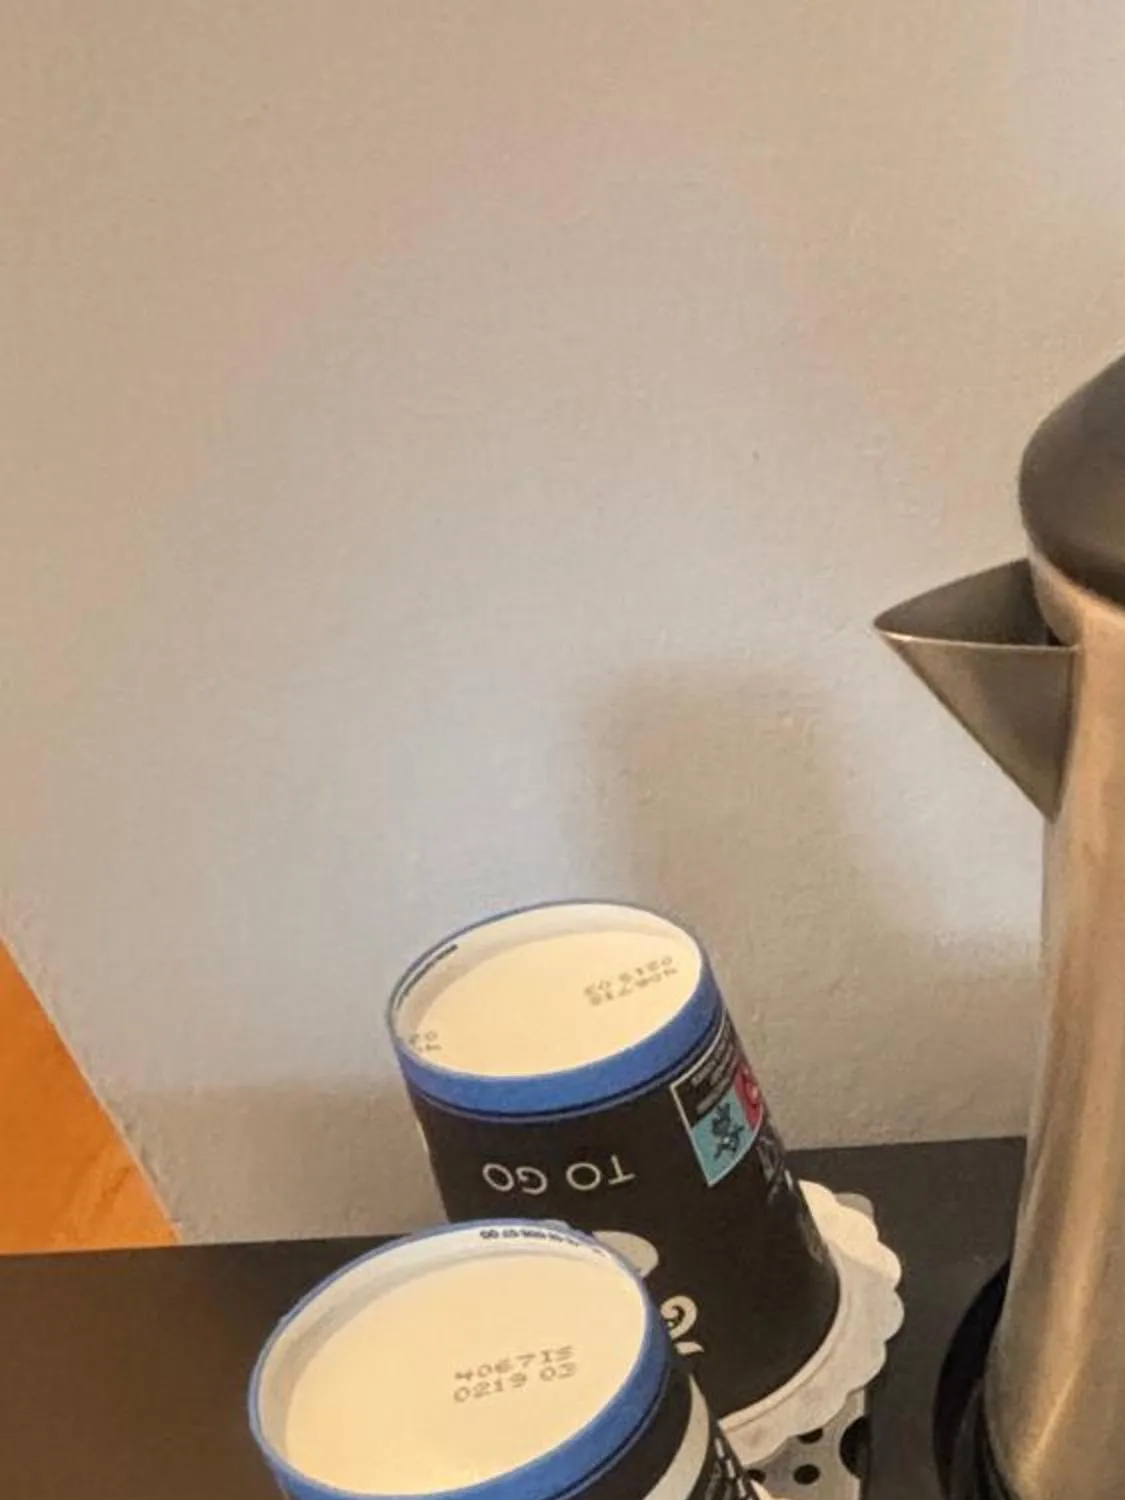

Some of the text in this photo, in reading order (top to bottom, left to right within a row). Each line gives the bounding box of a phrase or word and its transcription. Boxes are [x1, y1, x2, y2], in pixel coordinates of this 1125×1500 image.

[481, 1154, 637, 1195] TO GO
[453, 1371, 528, 1403] 0219
